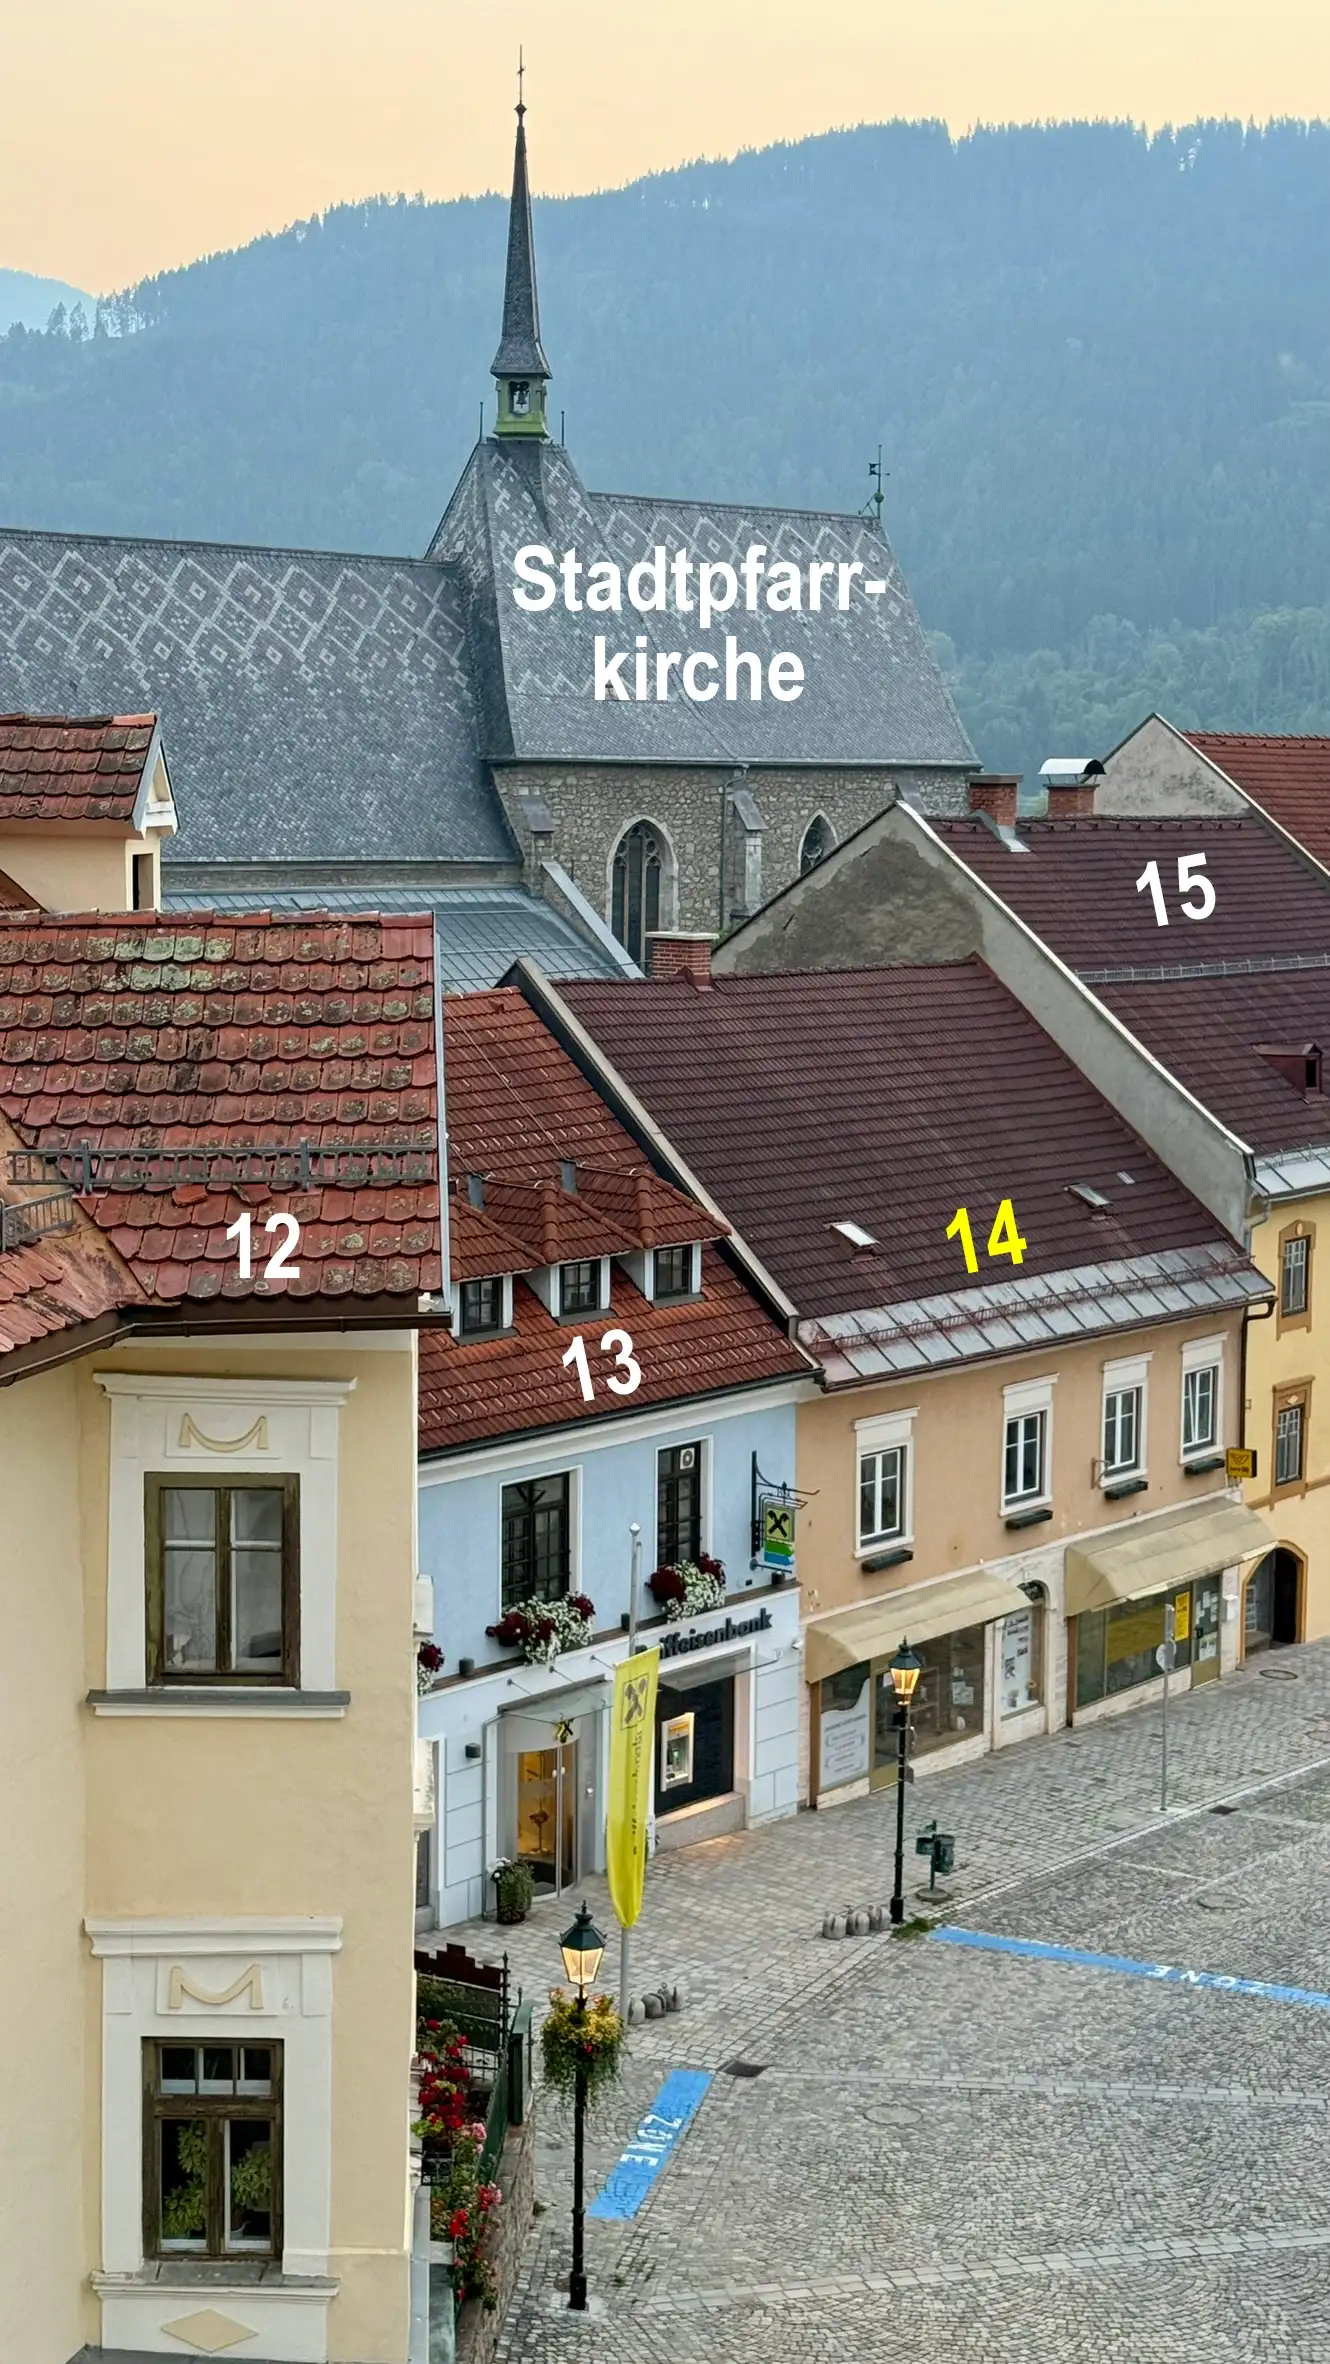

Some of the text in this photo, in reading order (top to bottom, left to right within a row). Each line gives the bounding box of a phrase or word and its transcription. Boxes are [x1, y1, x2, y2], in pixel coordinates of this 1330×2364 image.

[635, 1607, 773, 1660] iffeisenbank
[1145, 1963, 1273, 1995] ZONE
[619, 2113, 683, 2168] ZONE
